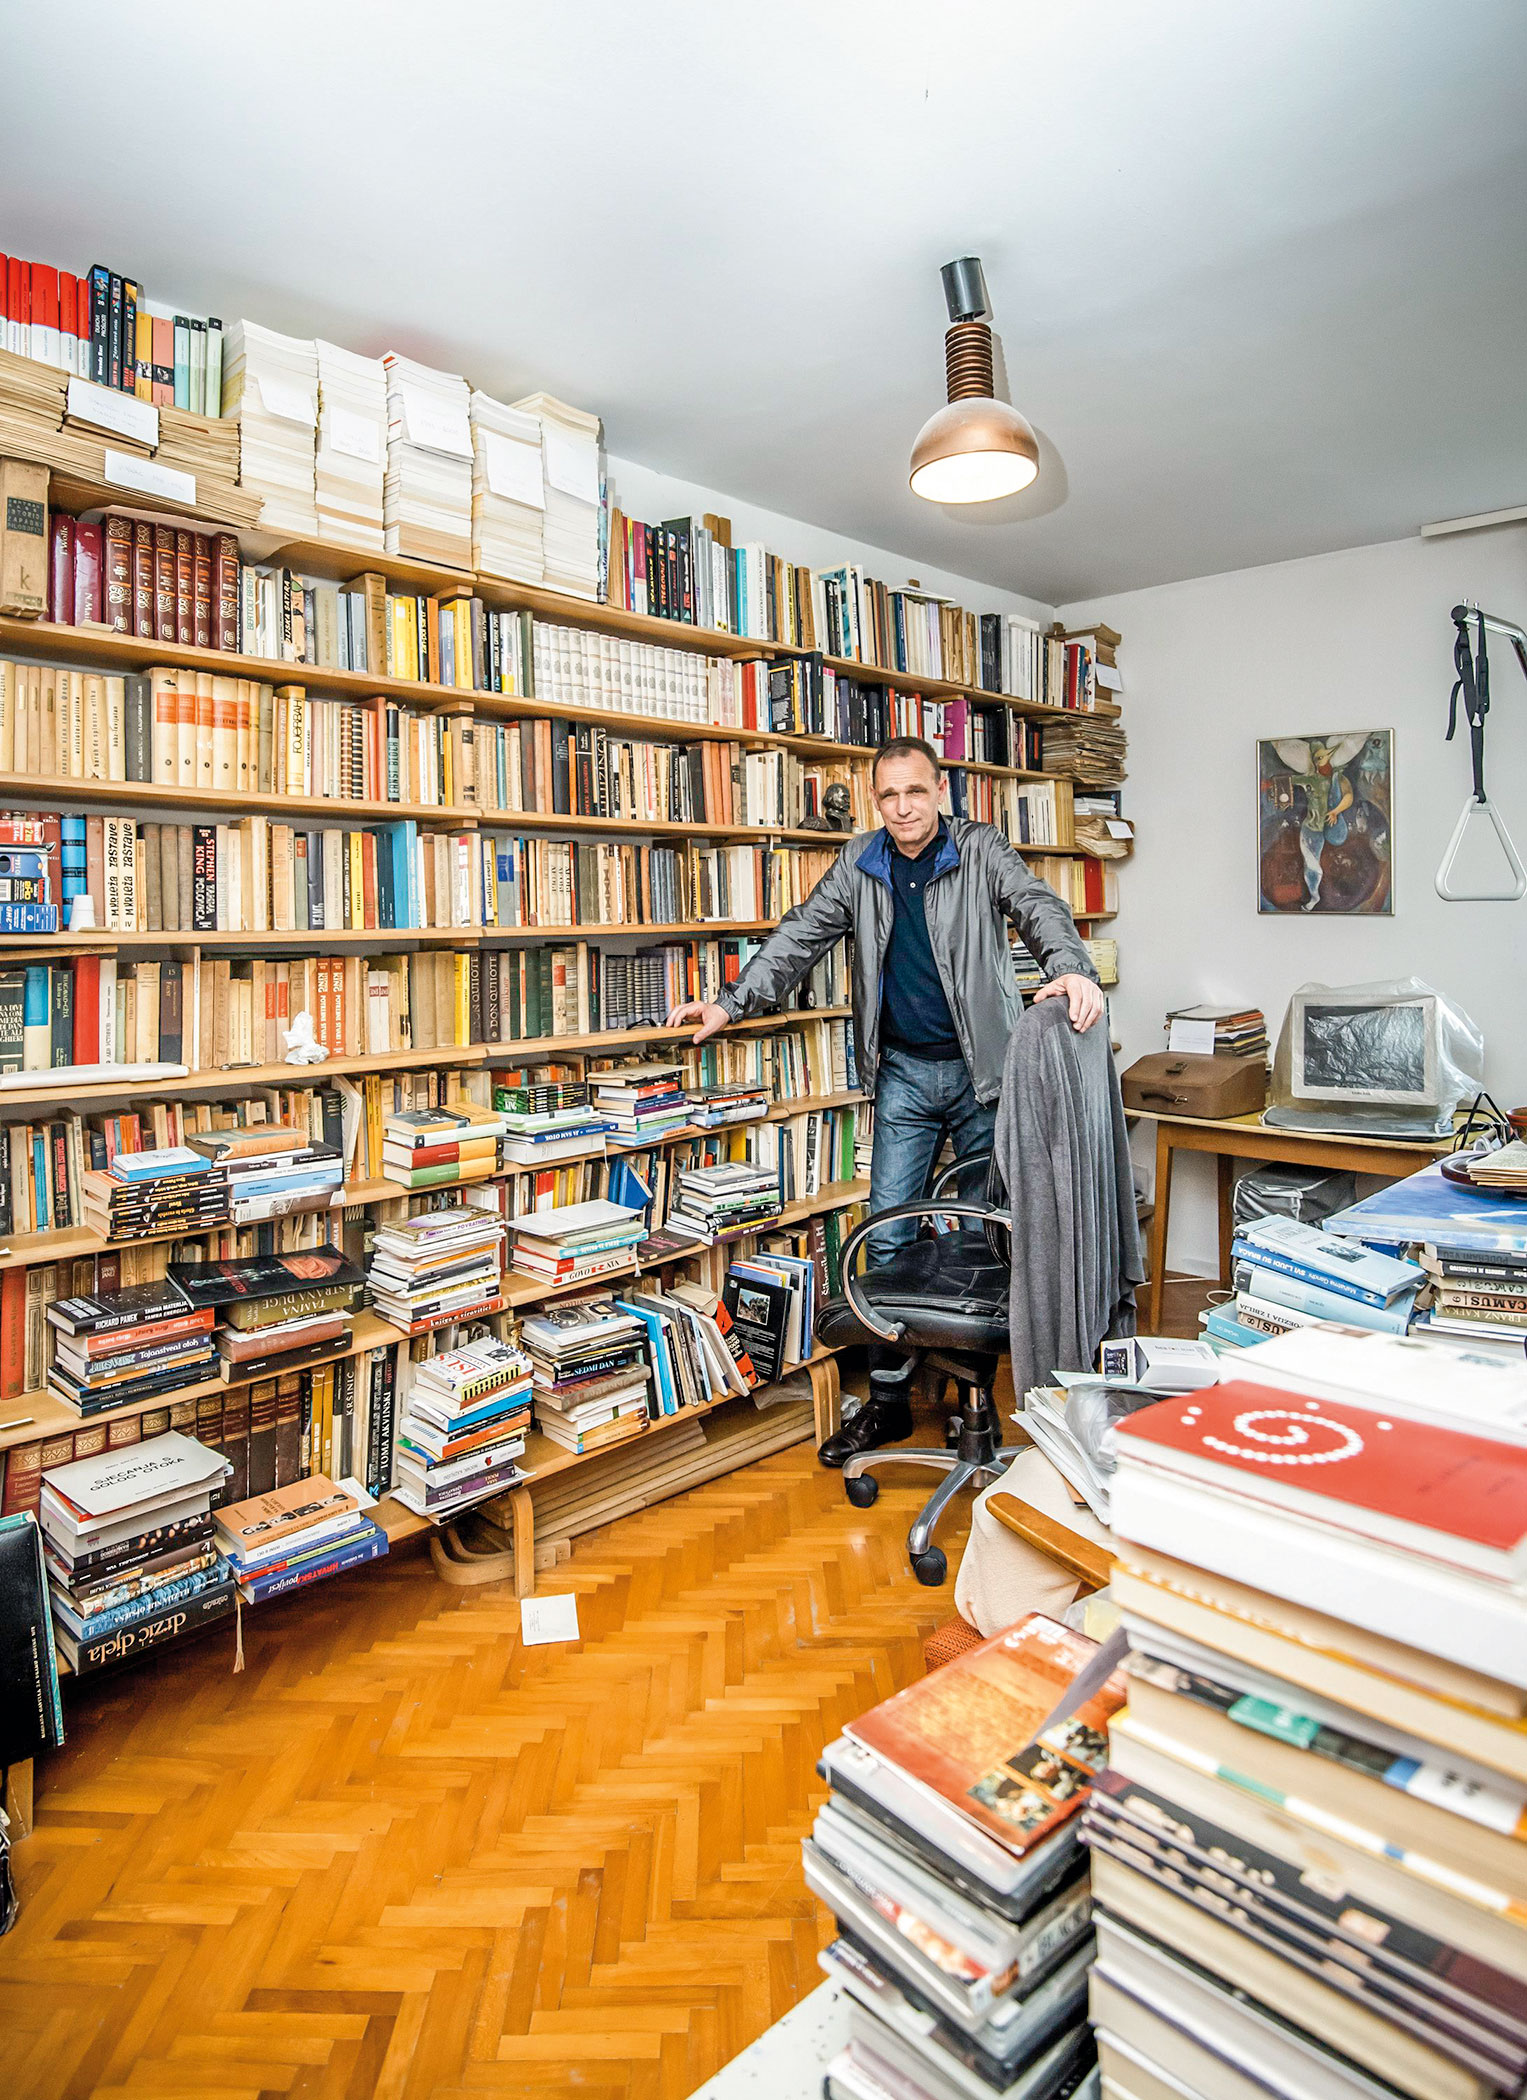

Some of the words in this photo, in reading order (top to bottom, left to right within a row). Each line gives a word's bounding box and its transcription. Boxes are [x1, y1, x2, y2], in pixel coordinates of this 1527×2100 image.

[247, 572, 255, 598] BREHT
[284, 580, 292, 612] SATIRA
[388, 741, 399, 766] BLOCH
[388, 769, 399, 794] ERNST
[195, 845, 205, 875] KING
[206, 838, 215, 882] STEPHEN
[195, 876, 206, 923] POLOVICA
[501, 977, 509, 1015] Faulkner
[472, 1003, 480, 1028] DON
[490, 1003, 498, 1028] DON
[1238, 1247, 1261, 1264] BRAĆA
[1262, 1256, 1272, 1268] SU
[1273, 1261, 1294, 1278] LJUDI
[1295, 1269, 1306, 1281] SVI
[1308, 1273, 1331, 1287] Gandhi
[1331, 1280, 1356, 1296] Mahatma
[1474, 1280, 1525, 1295] CAMUS
[262, 1294, 295, 1310] DUGE
[299, 1285, 346, 1304] STRANA
[144, 1306, 163, 1314] TAMNA
[162, 1300, 187, 1311] MATERIJA
[283, 1299, 326, 1316] TAMNA
[1239, 1303, 1265, 1315] ZBILJA
[1443, 1306, 1479, 1319] KAFKA
[1470, 1296, 1527, 1312] CAMUS
[94, 1317, 118, 1331] RICHARD
[117, 1313, 138, 1326] PANEK
[144, 1312, 163, 1321] TAMNA
[162, 1306, 188, 1317] ENERGIJA
[1246, 1316, 1255, 1325] 8
[1273, 1314, 1304, 1329] OEZIJA
[1483, 1309, 1522, 1323] FRANZ
[182, 1337, 199, 1350] otok
[574, 1361, 597, 1376] SEDMI
[598, 1359, 615, 1371] DAN
[382, 1391, 391, 1437] AKVINSKI
[302, 1435, 310, 1468] ATLAS
[381, 1438, 391, 1469] TOMA
[89, 1474, 137, 1492] GOLOG
[143, 1457, 186, 1474] OTOKA
[268, 1574, 301, 1594] povijest
[88, 1631, 135, 1663] djela
